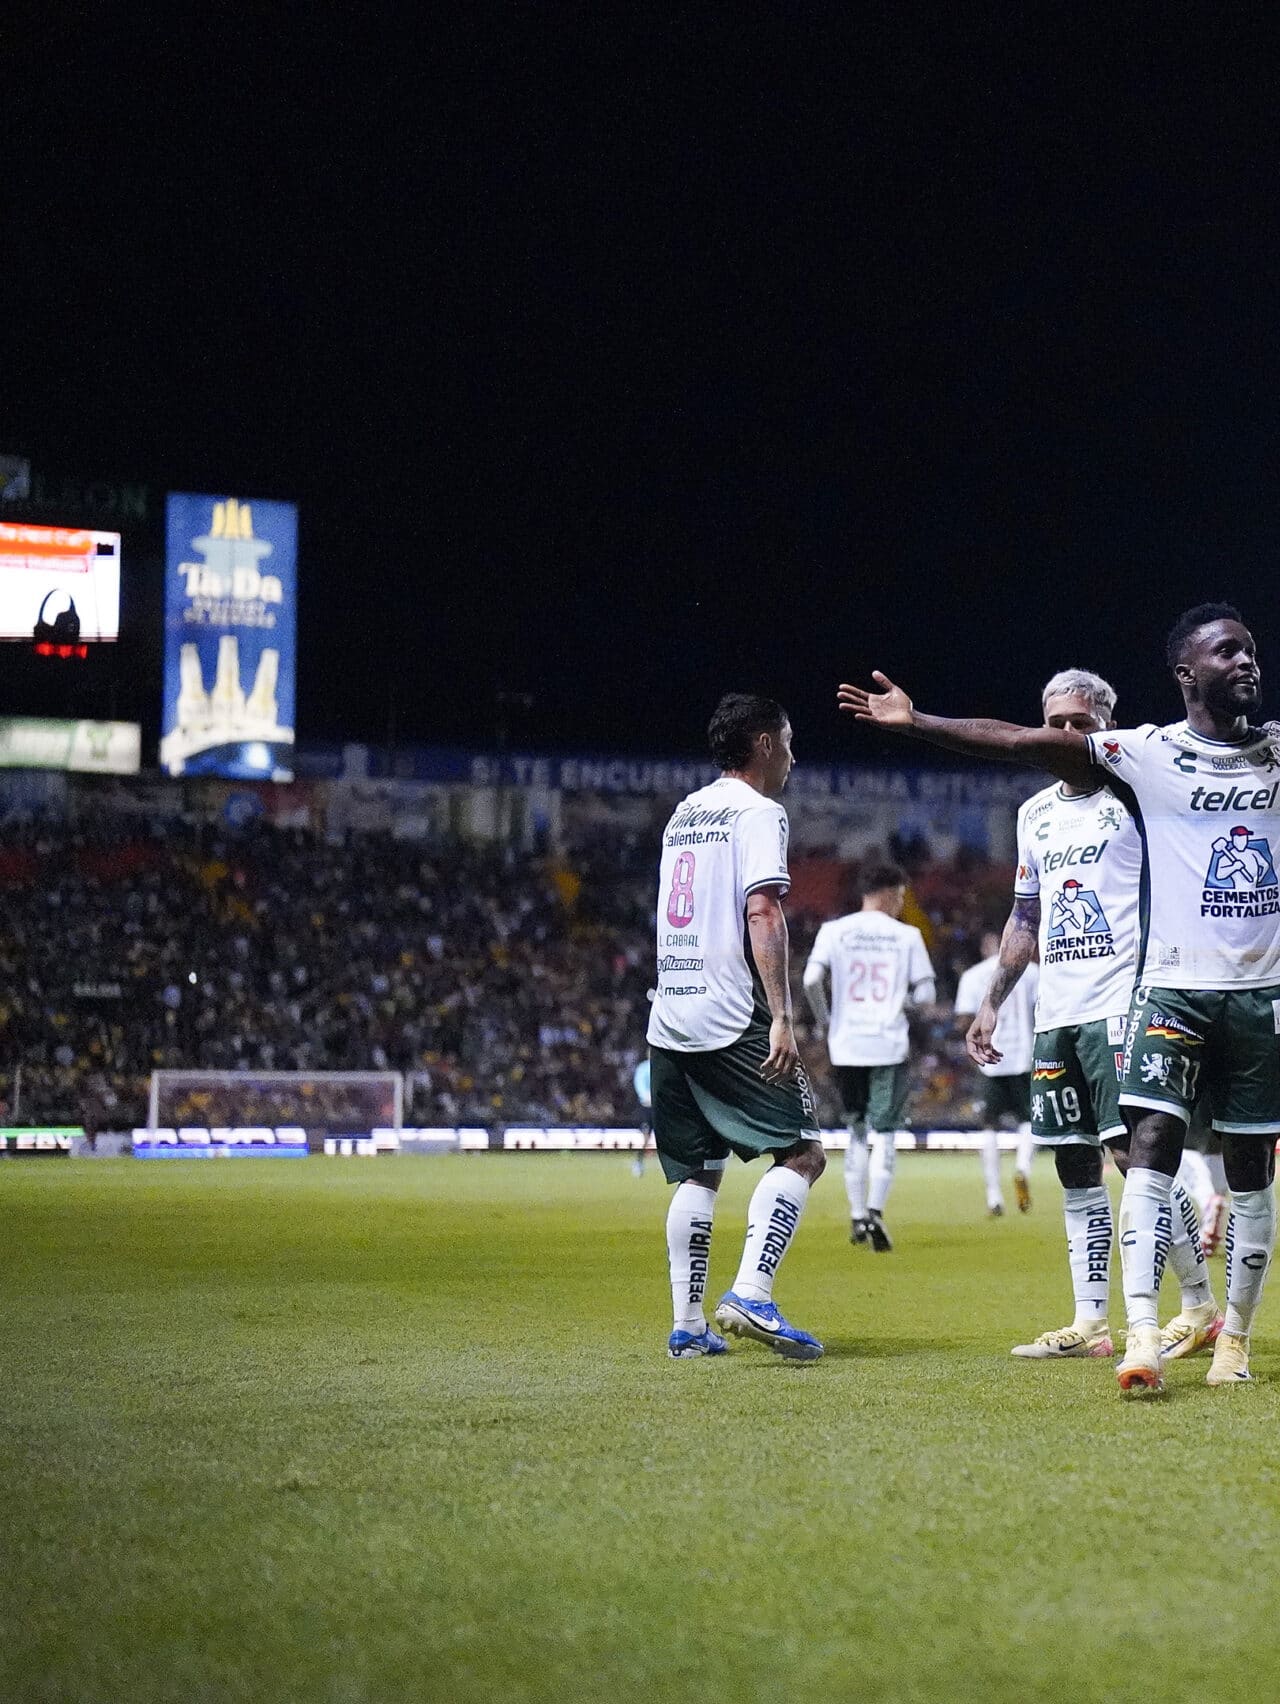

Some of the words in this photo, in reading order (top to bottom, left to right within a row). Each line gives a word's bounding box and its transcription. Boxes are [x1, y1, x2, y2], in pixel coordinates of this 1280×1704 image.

[561, 760, 716, 791] ENCUENT
[1191, 782, 1280, 812] telcel
[665, 830, 731, 847] aliente.mx
[1042, 839, 1109, 874] telcel
[666, 850, 697, 929] 8
[1202, 887, 1280, 905] CEMENTOS
[1200, 900, 1280, 919] FORTALEZA
[666, 934, 700, 948] CABRAL
[1044, 945, 1116, 966] FORTALEZA
[1046, 933, 1114, 953] CEMENTOS
[664, 986, 707, 996] mazda
[849, 962, 889, 1002] 25
[1122, 1009, 1143, 1082] PROXEL
[795, 1062, 814, 1117] ROXEL
[1045, 1086, 1082, 1127] 19
[757, 1196, 800, 1278] PERDURA
[1086, 1206, 1113, 1283] PERDURA
[690, 1221, 713, 1304] PERDURA
